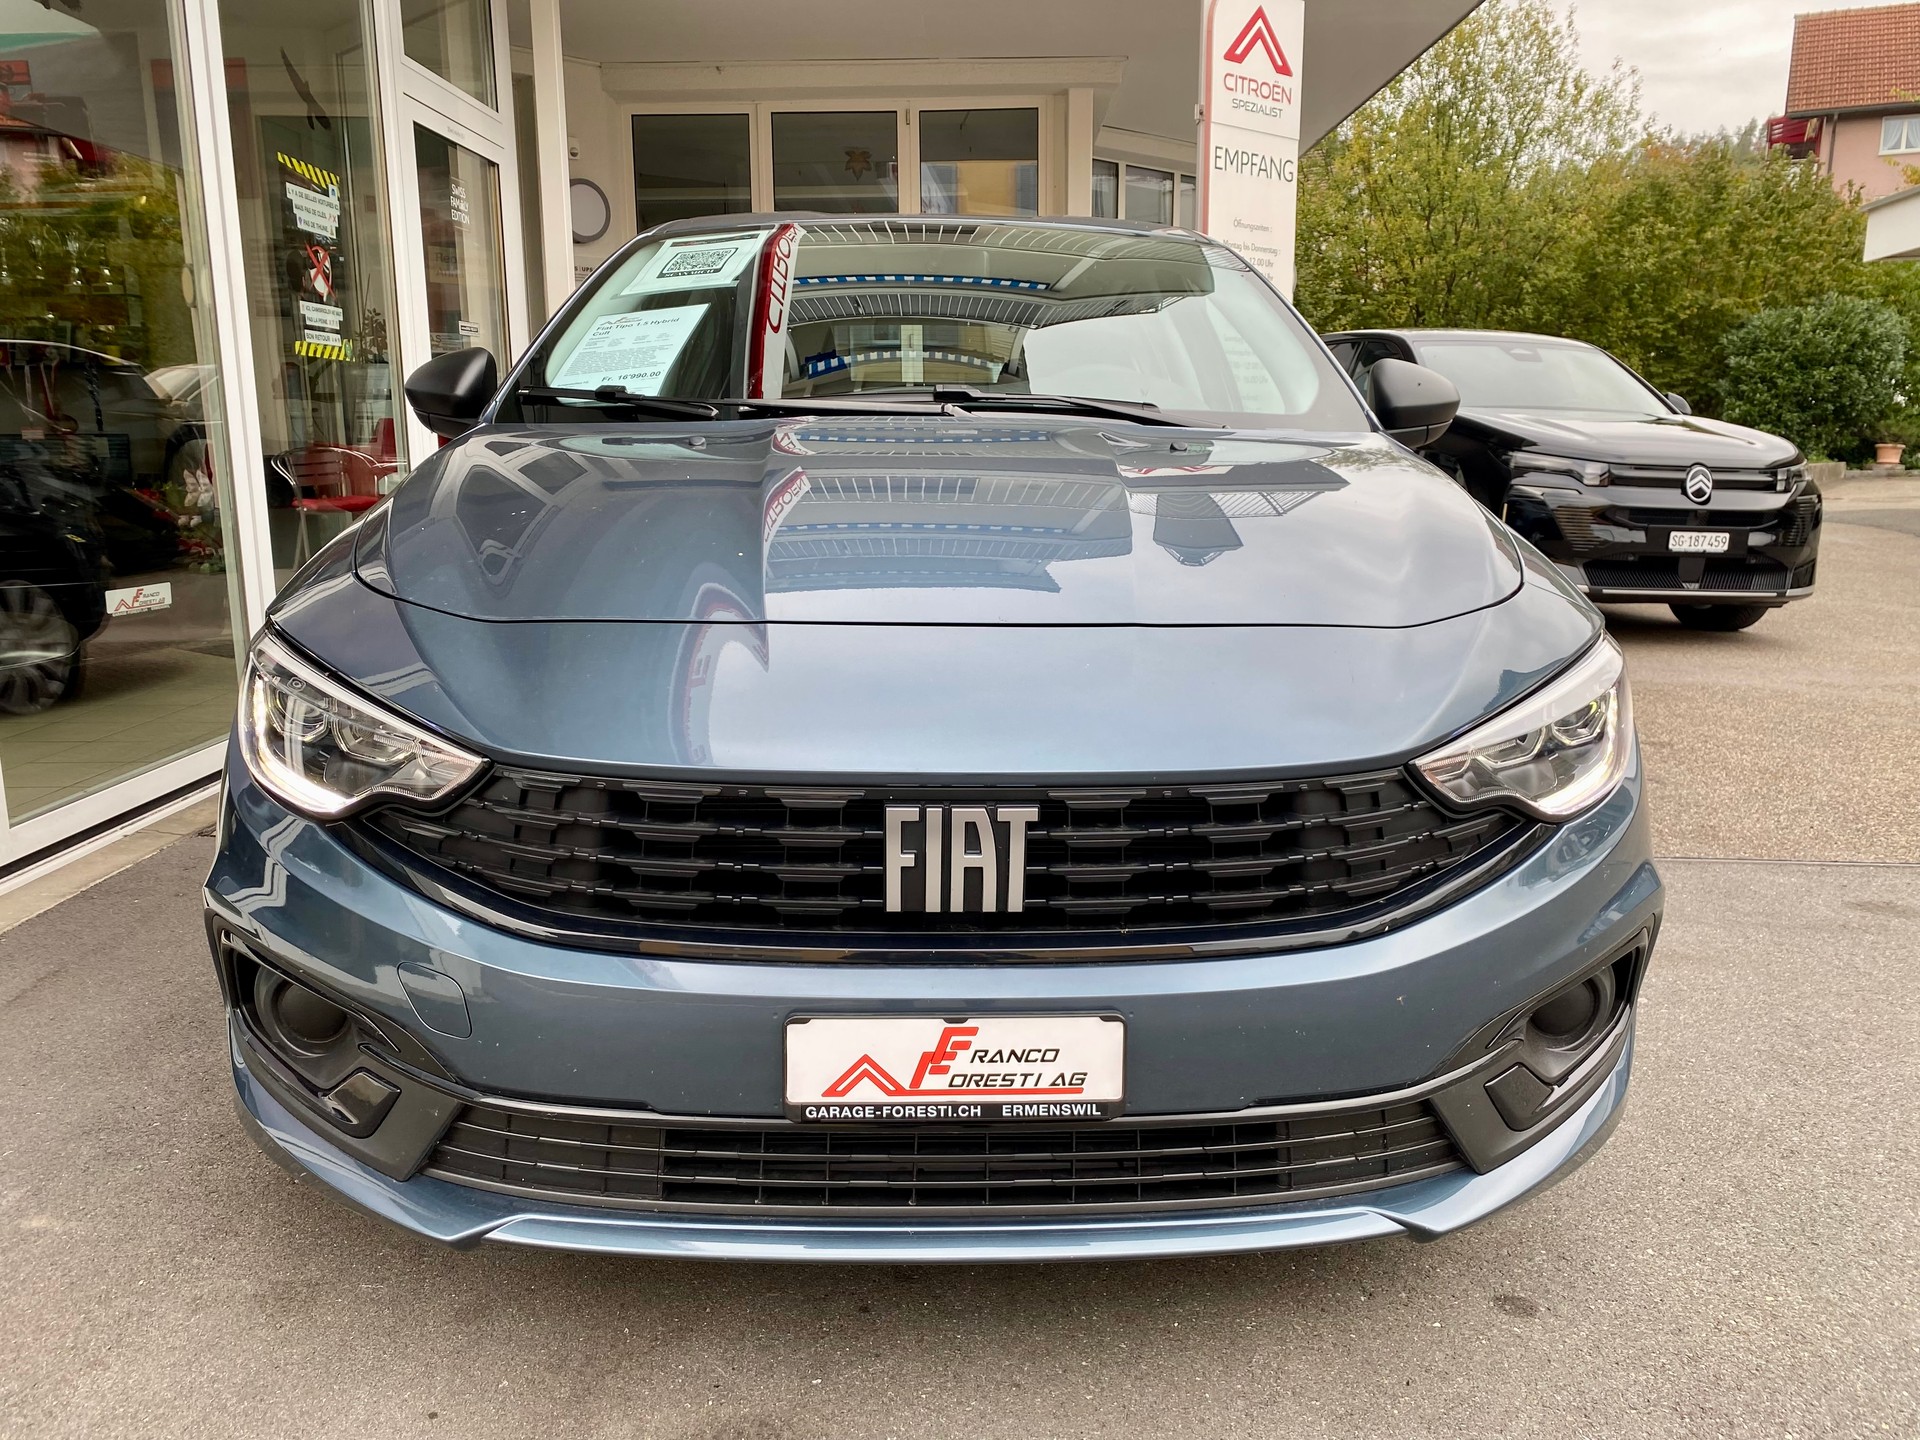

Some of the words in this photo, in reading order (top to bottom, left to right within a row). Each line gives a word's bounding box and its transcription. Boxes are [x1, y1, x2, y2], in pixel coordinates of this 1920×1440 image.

[1224, 72, 1292, 105] CITROËN
[1232, 98, 1283, 118] SPEZIALIST
[1214, 145, 1294, 182] EMPFANG
[650, 317, 680, 325] Hybrid
[618, 370, 662, 381] 16'990.00
[885, 805, 1039, 913] FIAT
[931, 1026, 1060, 1064] FRANCO
[909, 1051, 1043, 1089] FORESTI
[1049, 1072, 1088, 1087] AG
[805, 1105, 982, 1118] GARAGE-FORESTI.CH
[1002, 1103, 1101, 1116] ERMENSWIL
